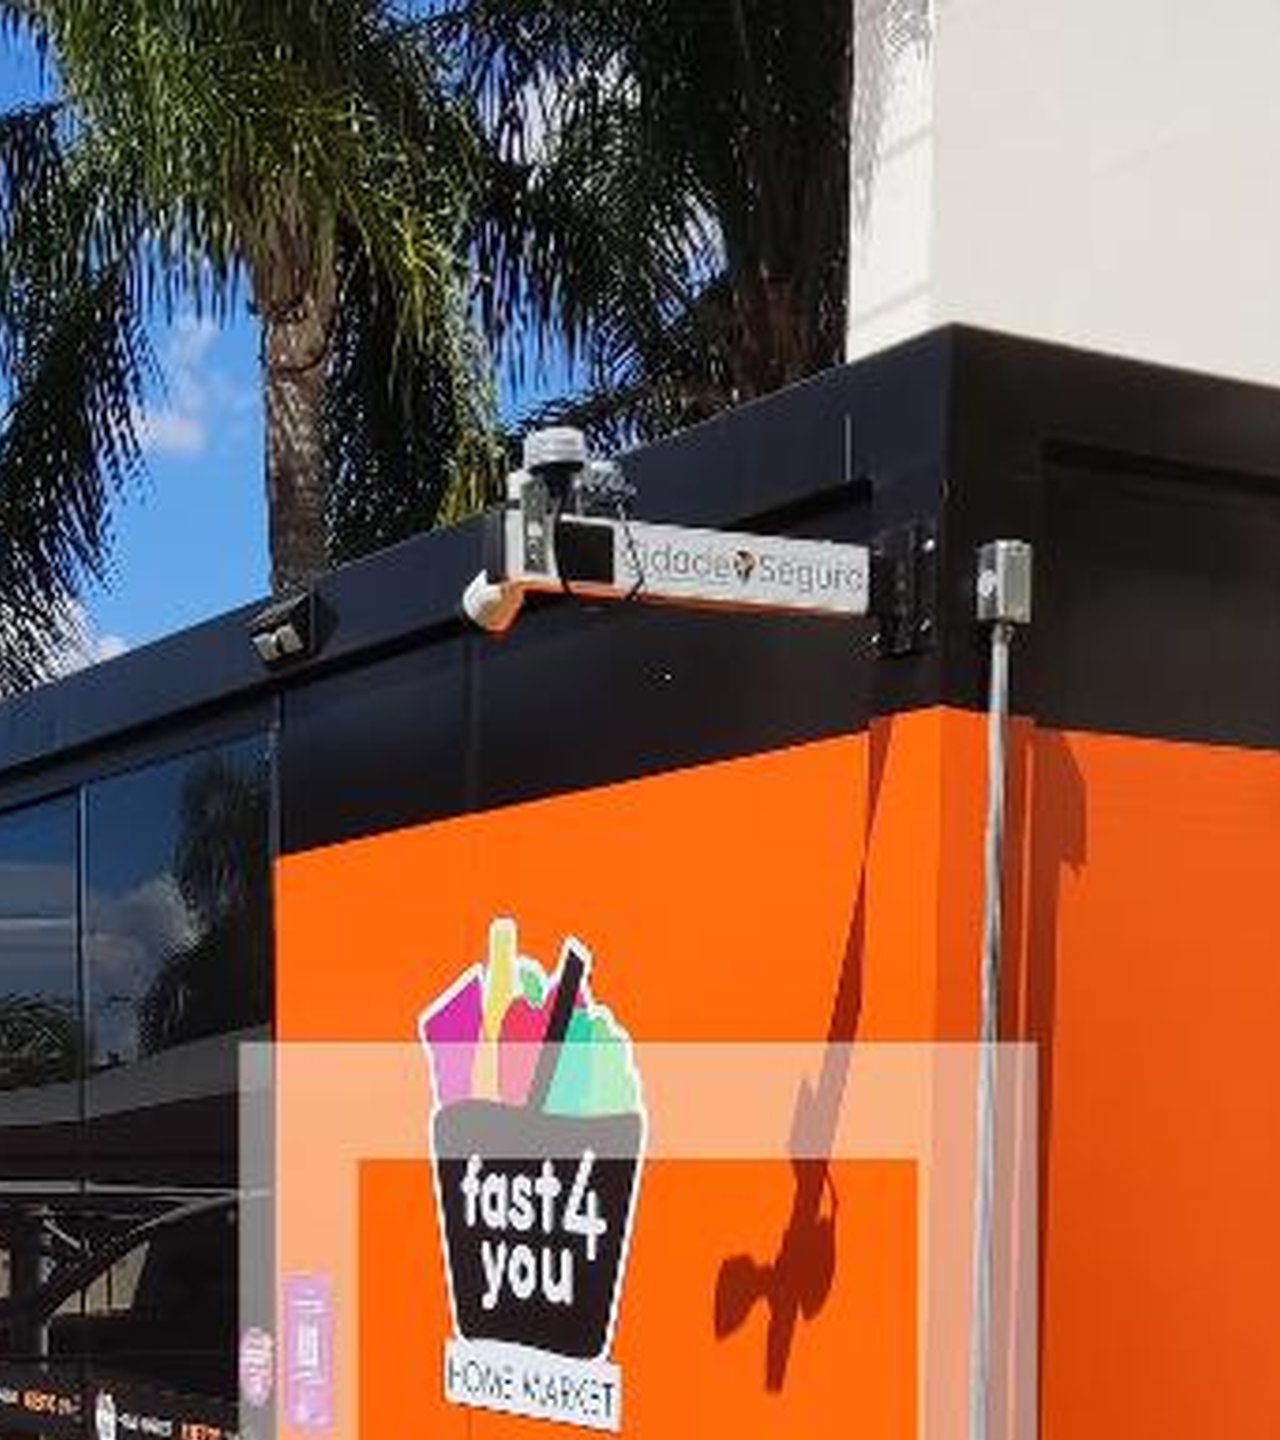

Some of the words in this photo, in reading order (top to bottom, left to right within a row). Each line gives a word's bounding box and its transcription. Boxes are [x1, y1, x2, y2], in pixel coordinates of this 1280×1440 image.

[461, 1153, 561, 1233] fast
[562, 1150, 607, 1261] 4
[481, 1240, 573, 1310] you
[447, 1356, 513, 1401] HOME
[522, 1369, 615, 1419] MARKET
